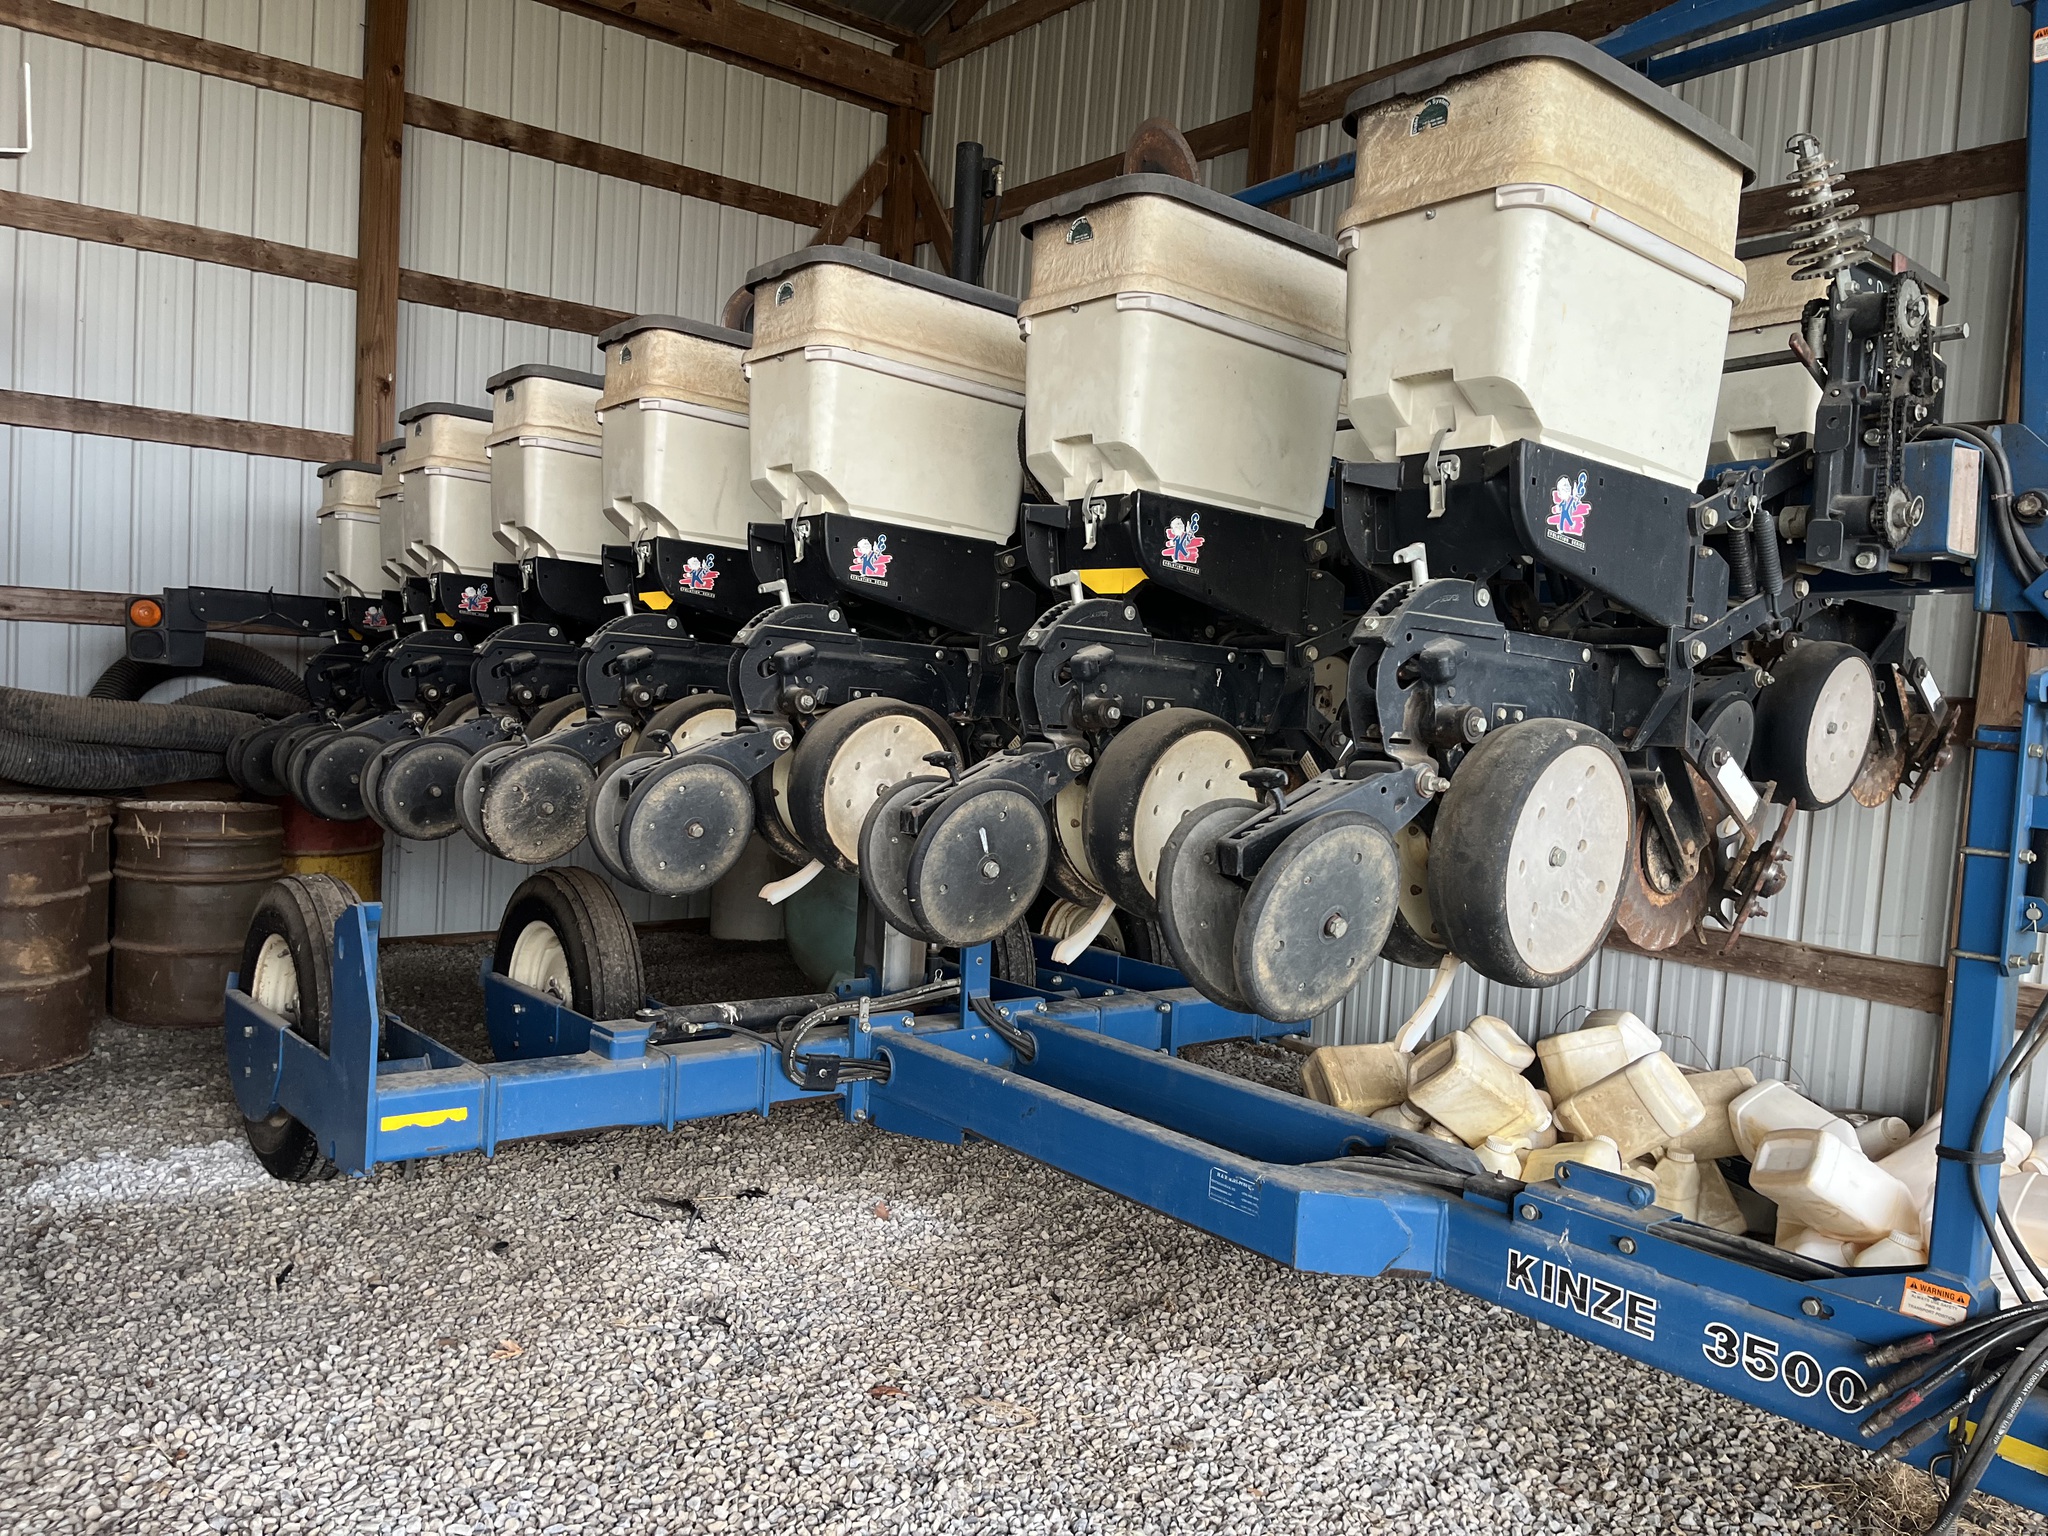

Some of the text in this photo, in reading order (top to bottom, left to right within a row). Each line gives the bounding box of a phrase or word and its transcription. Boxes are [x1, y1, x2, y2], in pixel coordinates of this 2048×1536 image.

[1506, 1248, 1657, 1341] KINZE
[1911, 1293, 1930, 1303] ALWAYS
[1941, 1301, 1958, 1311] SAFETY
[1919, 1283, 1956, 1300] WARNING
[1908, 1303, 1956, 1321] TRANSPORT POSITION
[1701, 1321, 1869, 1415] 3500
[2006, 1396, 2023, 1421] 4000PSI
